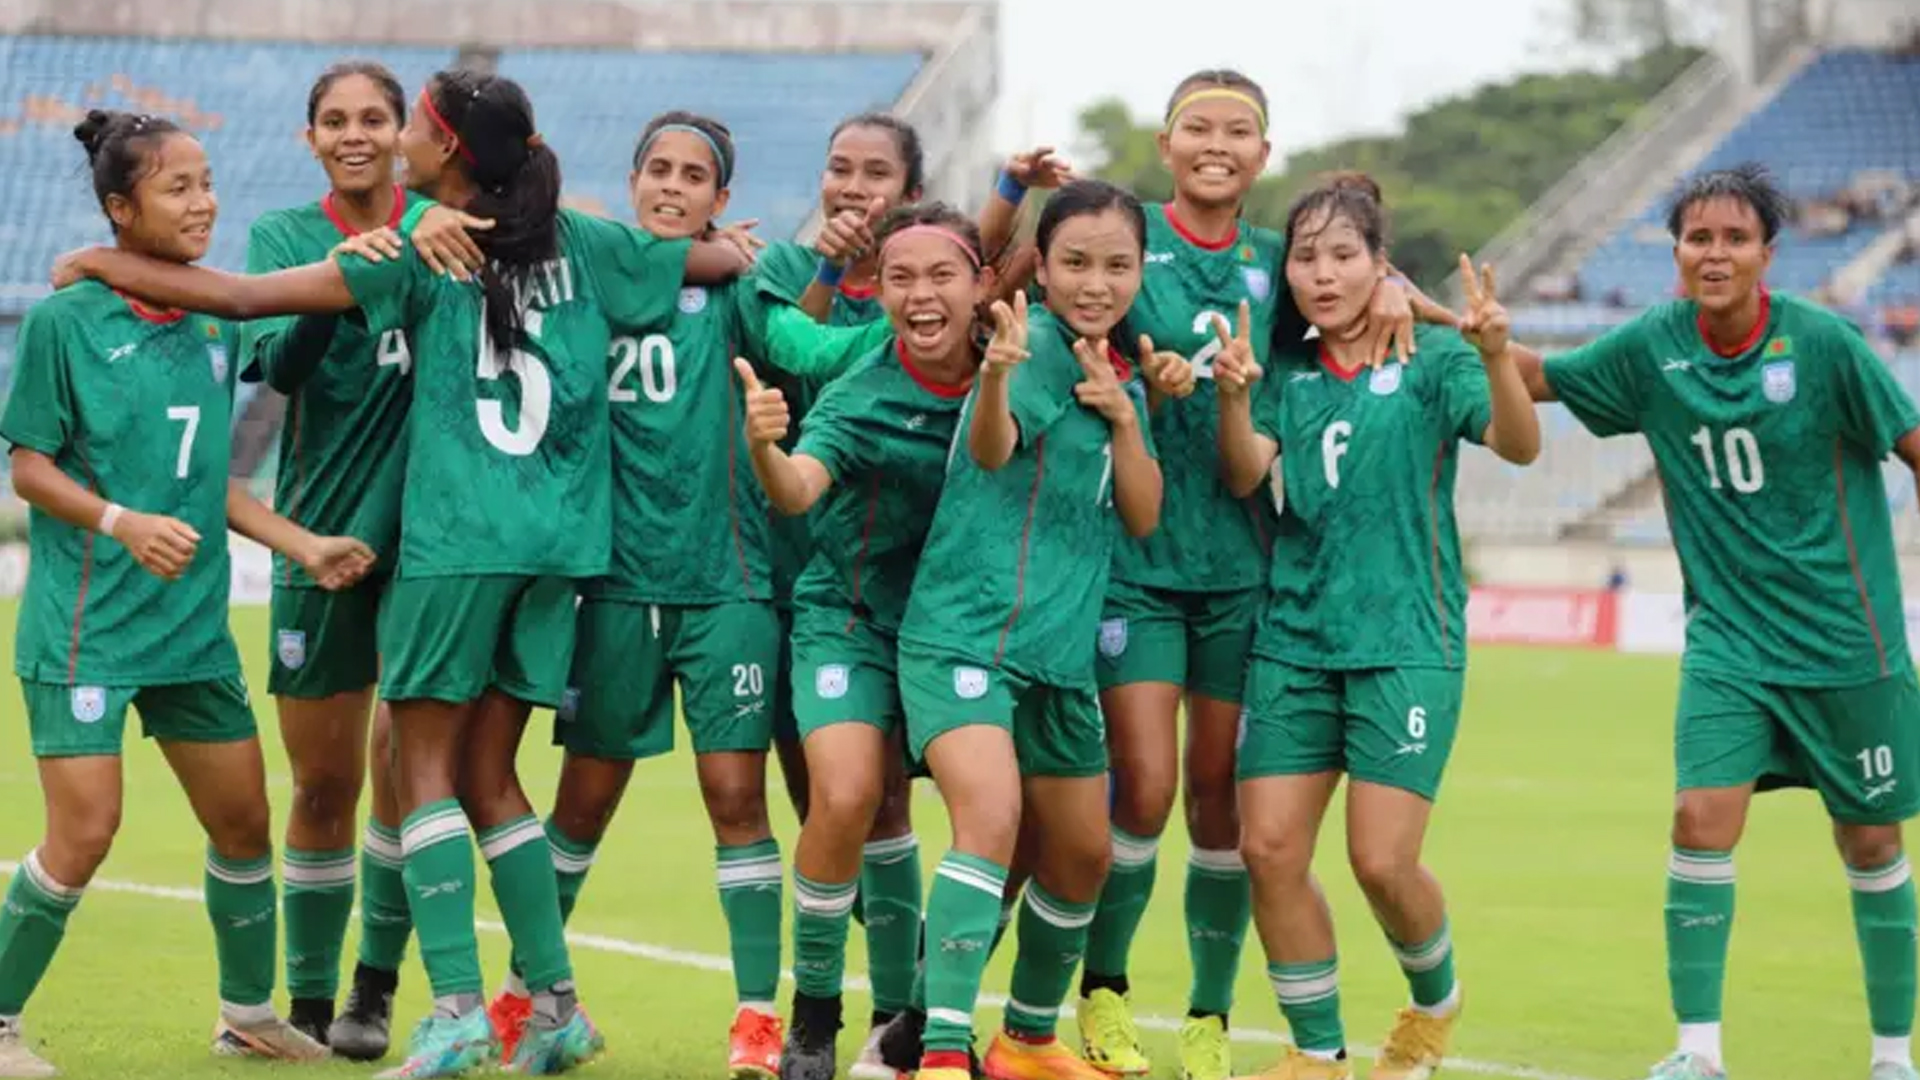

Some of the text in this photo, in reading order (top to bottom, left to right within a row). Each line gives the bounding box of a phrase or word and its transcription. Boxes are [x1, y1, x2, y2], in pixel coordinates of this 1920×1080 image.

[377, 329, 411, 375] 4
[476, 298, 551, 456] 5
[608, 334, 677, 402] 20
[1192, 310, 1232, 382] 2
[167, 405, 200, 479] 7
[1690, 425, 1764, 493] 10
[732, 663, 764, 696] 20
[1408, 706, 1427, 738] 6
[1856, 746, 1893, 779] 10
